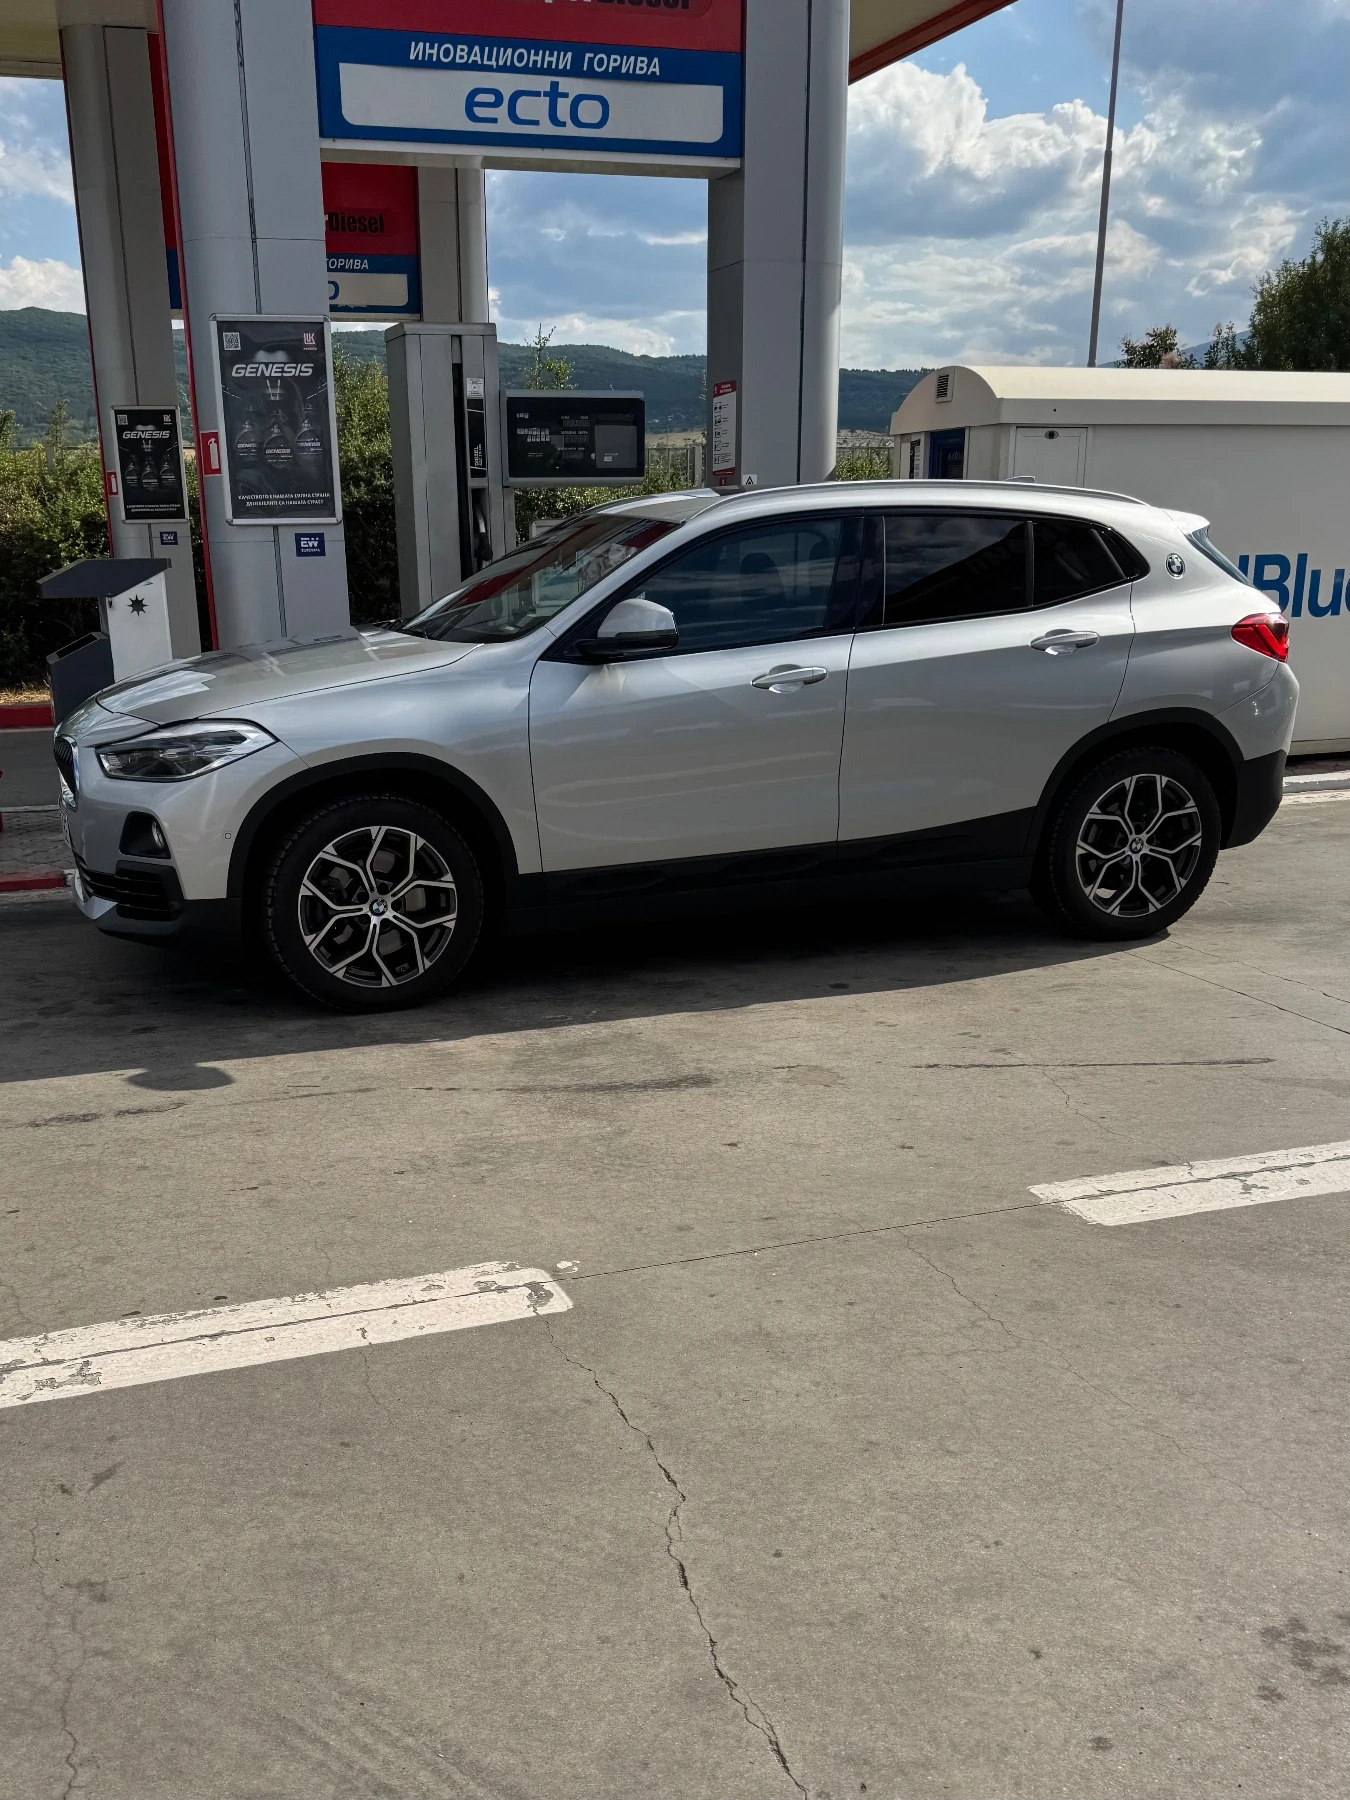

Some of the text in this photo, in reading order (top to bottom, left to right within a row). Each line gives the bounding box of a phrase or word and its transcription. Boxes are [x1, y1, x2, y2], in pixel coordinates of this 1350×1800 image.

[409, 41, 660, 76] ИНОВАЦИОННИ ГОРИВА
[465, 80, 610, 130] ecto
[231, 363, 314, 377] GENESIS
[122, 430, 171, 439] GENESIS
[1238, 553, 1350, 618] Blu
